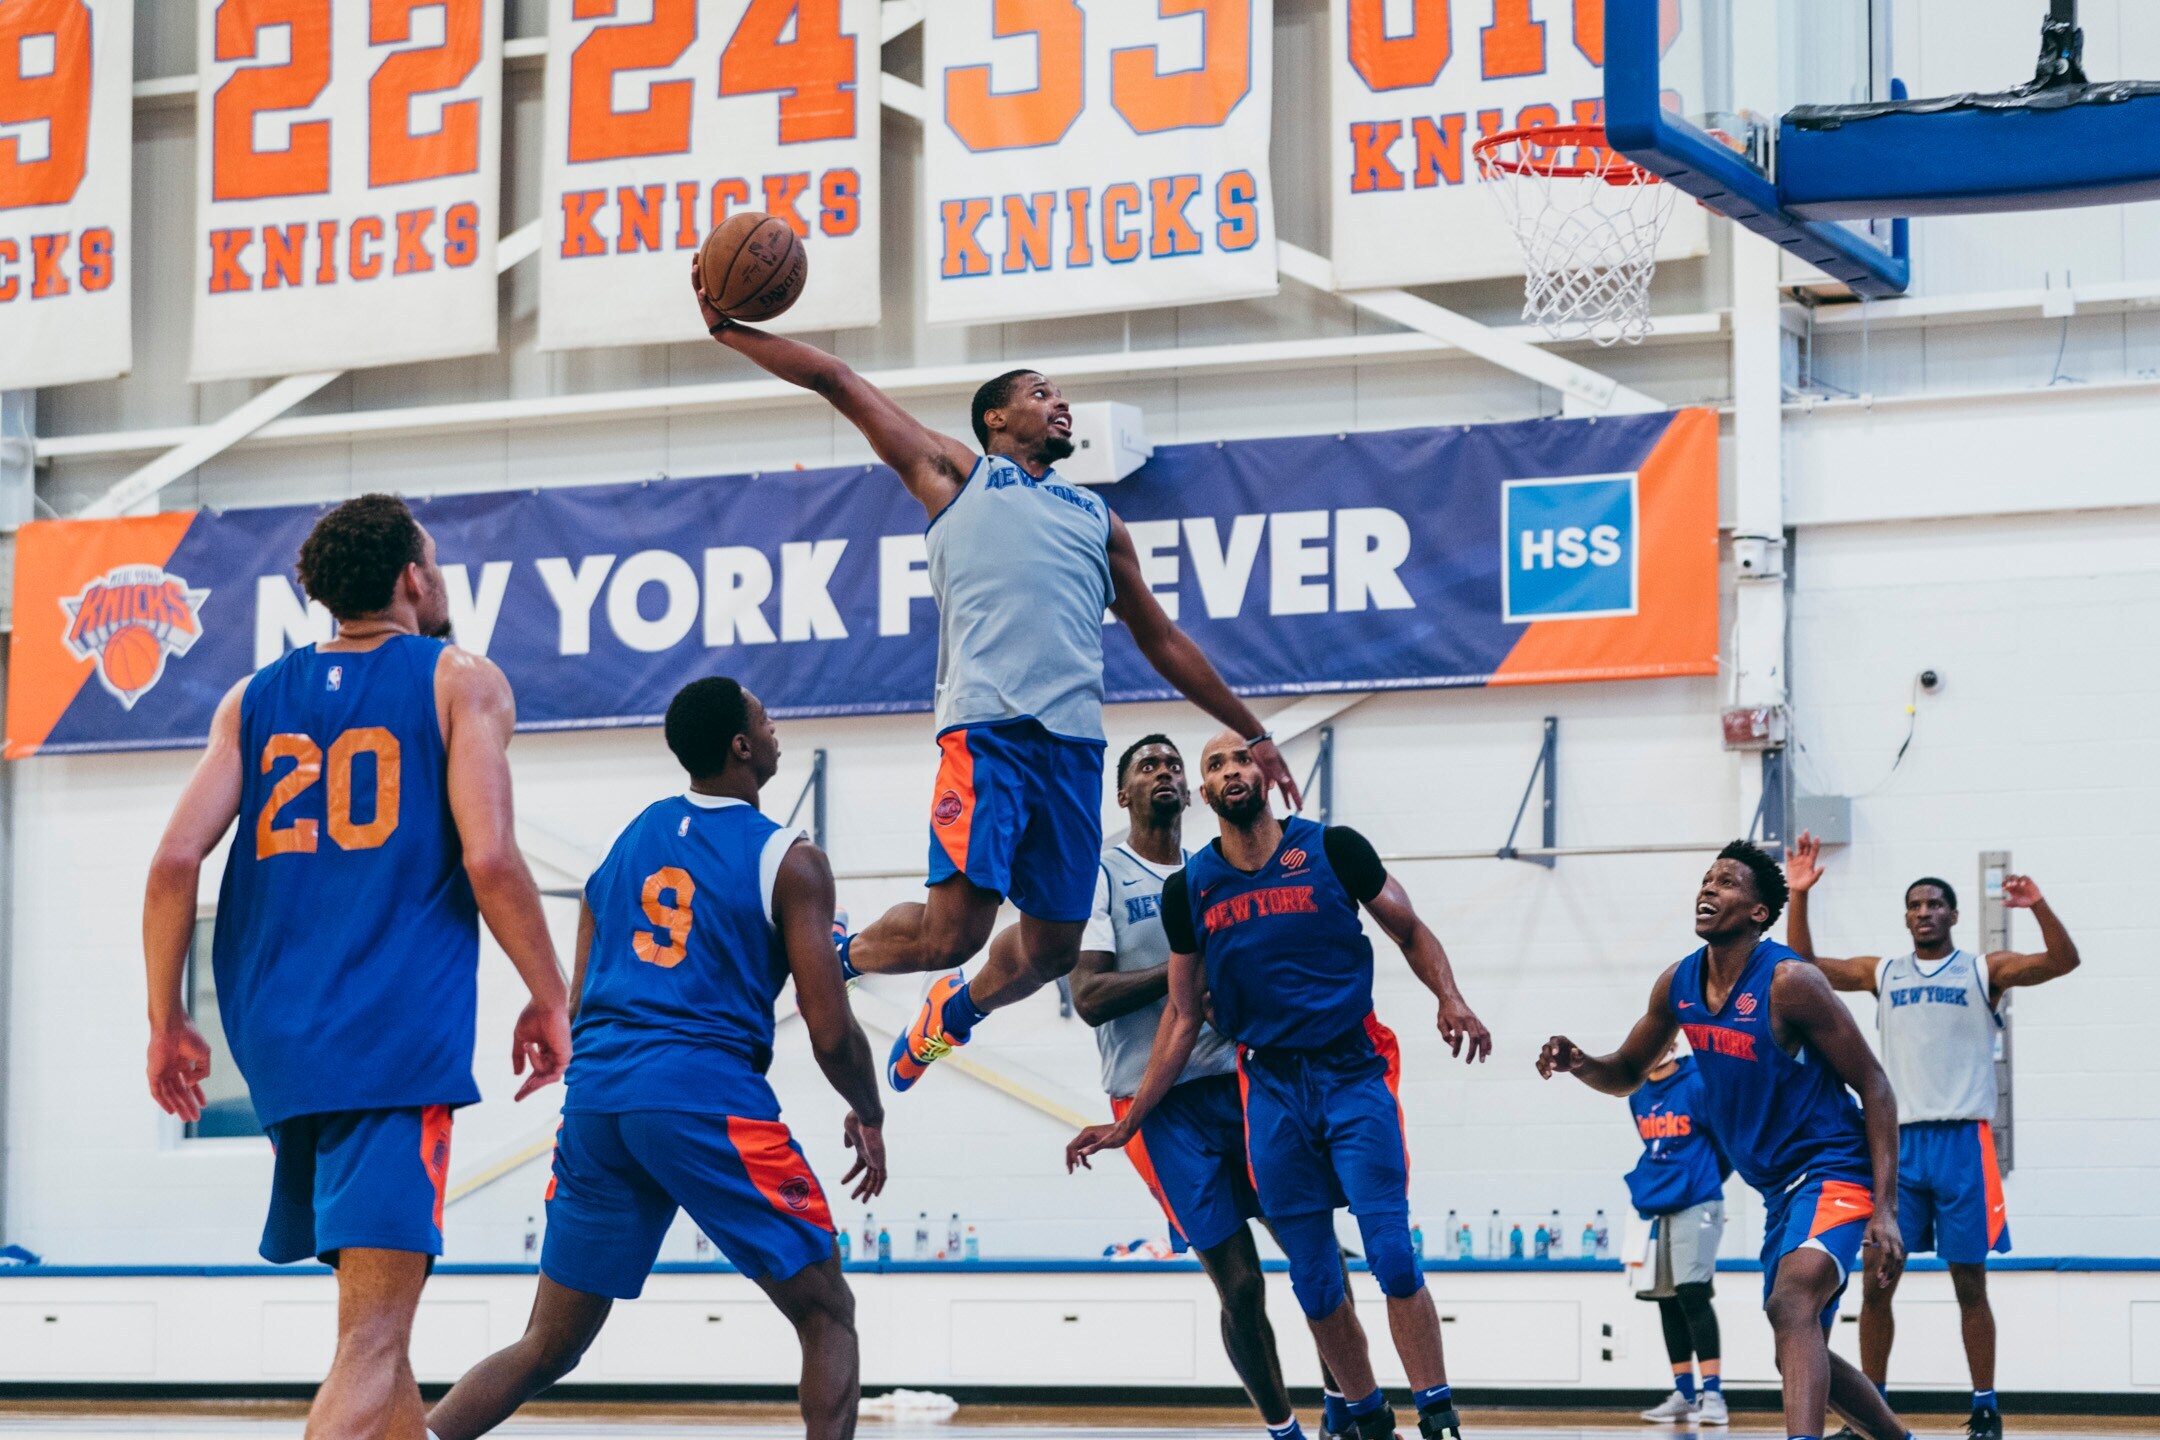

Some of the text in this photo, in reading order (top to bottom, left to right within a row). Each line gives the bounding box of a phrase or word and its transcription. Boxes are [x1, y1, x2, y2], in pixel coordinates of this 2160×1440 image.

[211, 0, 485, 203] 22
[567, 0, 857, 165] 24
[207, 200, 481, 295] KNICKS
[940, 168, 1260, 280] KNICKS
[984, 465, 1039, 491] NEW
[256, 507, 1416, 671] NW YORK FEVER
[1521, 524, 1622, 570] HSS
[69, 579, 196, 642] KNICKS
[256, 726, 401, 861] 20
[632, 865, 697, 969] 9
[1204, 886, 1318, 936] NEW YORK
[1710, 1026, 1759, 1062] YORK
[1890, 985, 1969, 1009] NEW YORK
